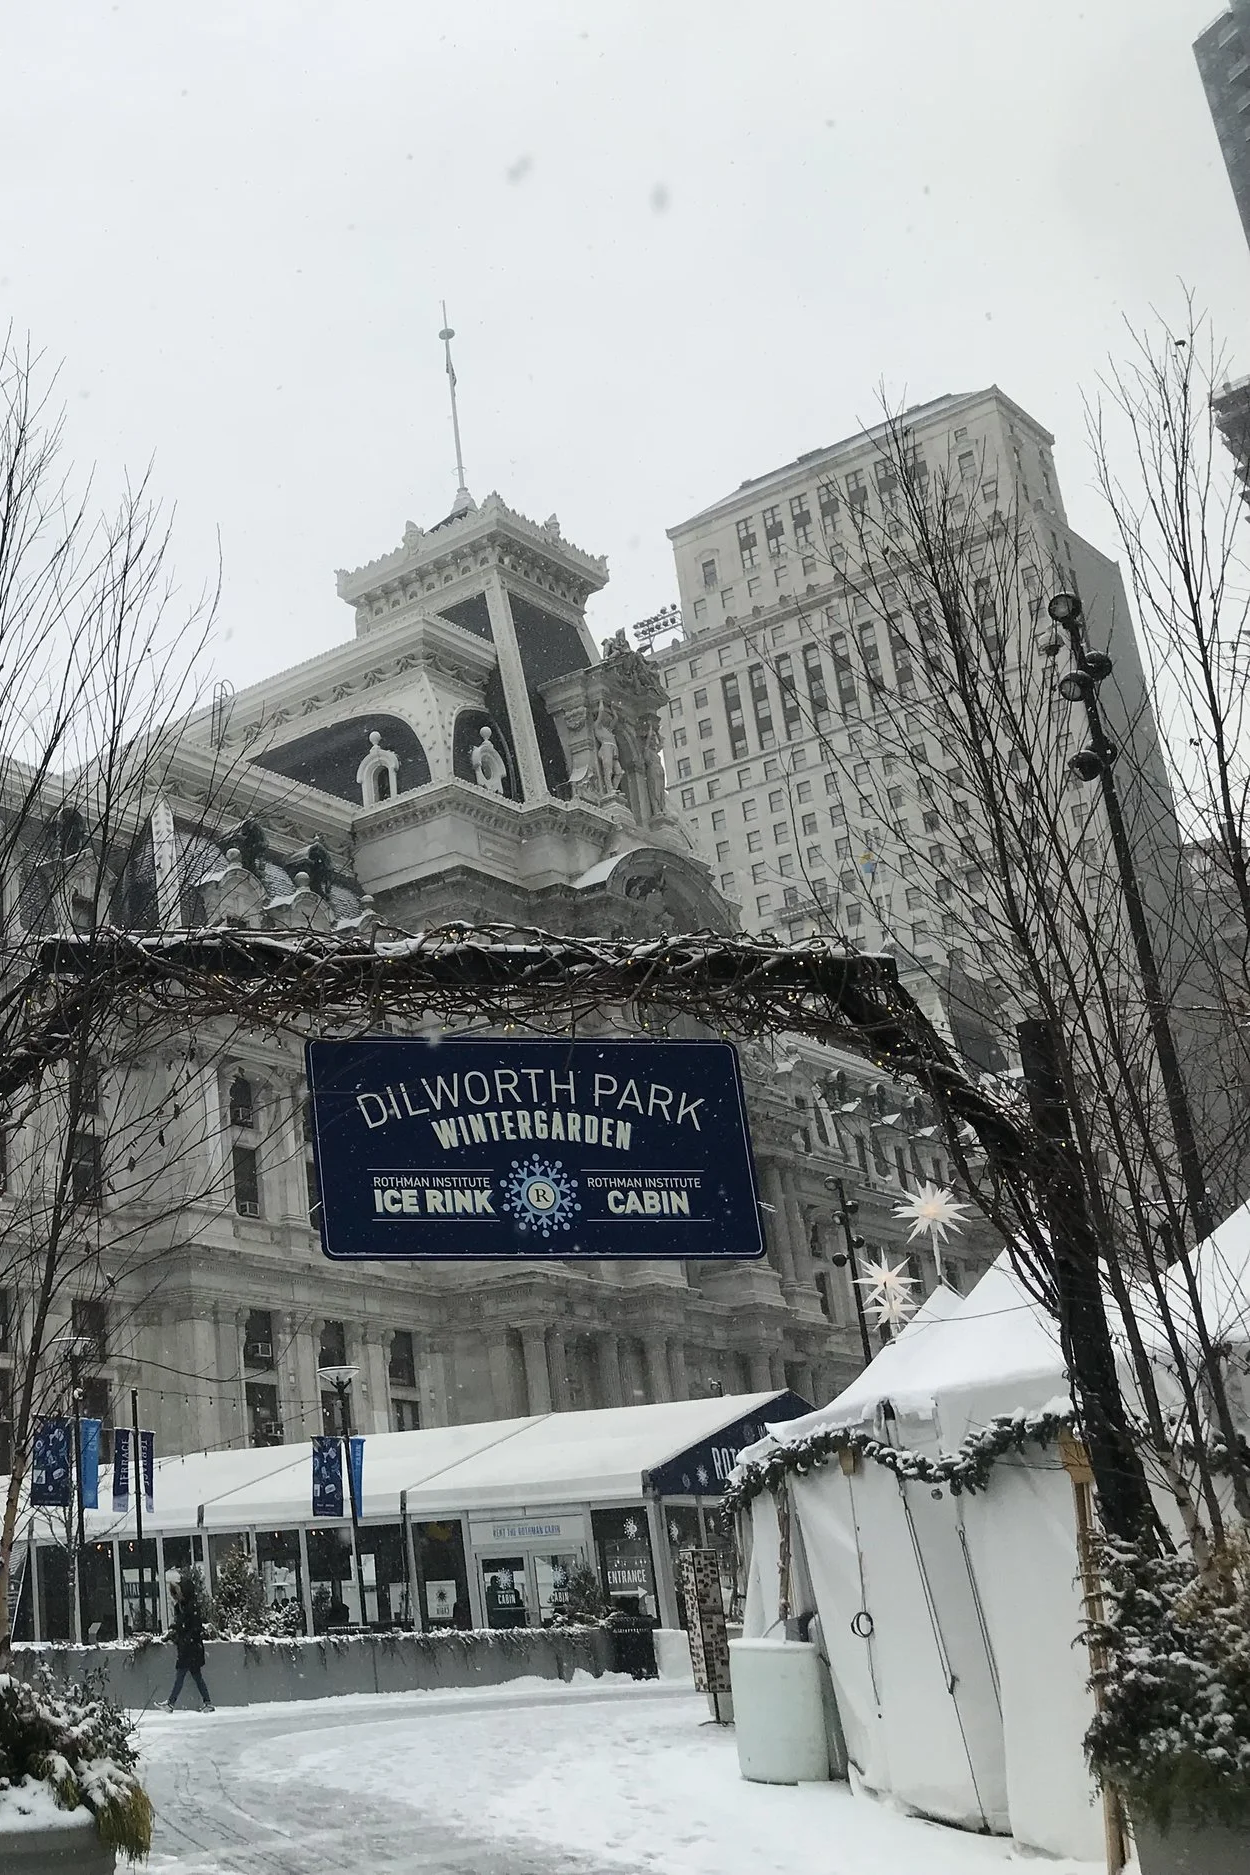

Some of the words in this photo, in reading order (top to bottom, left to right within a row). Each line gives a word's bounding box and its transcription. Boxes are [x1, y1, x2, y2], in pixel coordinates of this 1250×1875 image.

[355, 1068, 577, 1130] DILWORTH
[593, 1073, 706, 1132] PARK
[430, 1110, 632, 1151] WINTERGARDEN
[373, 1176, 431, 1189] ROTHMAN
[432, 1177, 491, 1189] INSTITUTE
[587, 1177, 642, 1189] ROTHMAN
[643, 1178, 702, 1189] INSTITUTE
[373, 1188, 422, 1214] ICE
[425, 1188, 497, 1215] RINK
[534, 1188, 551, 1203] R
[607, 1190, 692, 1216] CABIN
[119, 1439, 129, 1486] TERRACE
[607, 1569, 647, 1584] ENTRANCE
[497, 1593, 516, 1605] CABIN
